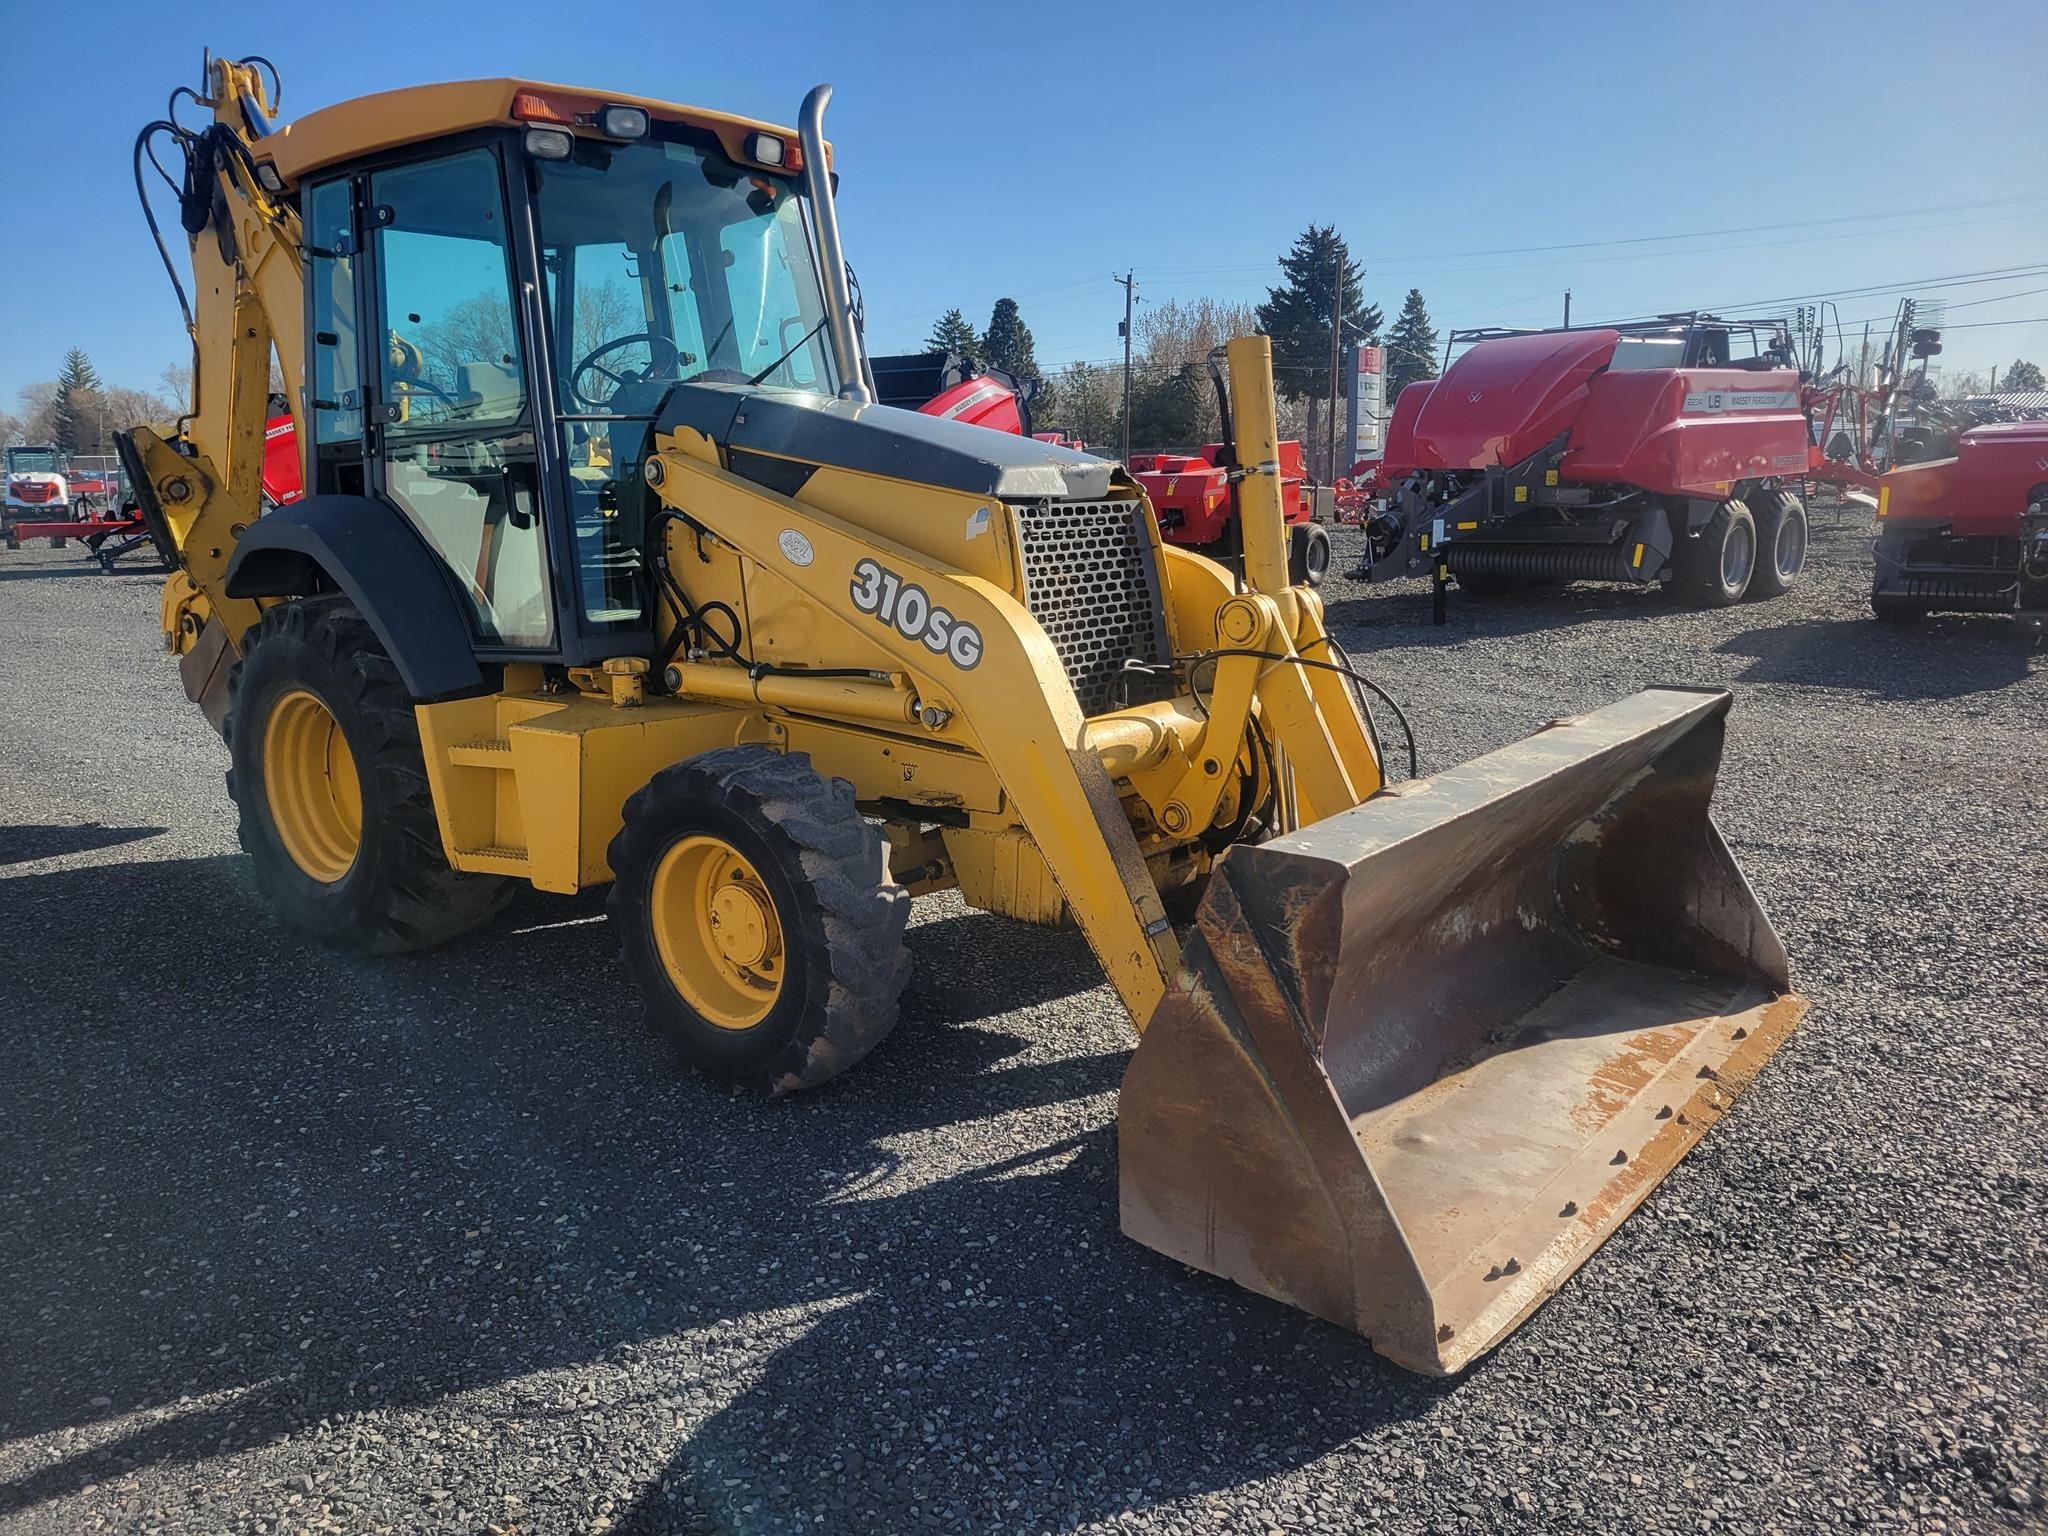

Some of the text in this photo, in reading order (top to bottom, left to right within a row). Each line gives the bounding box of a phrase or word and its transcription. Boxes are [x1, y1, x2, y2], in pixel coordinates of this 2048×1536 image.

[1708, 394, 1722, 409] LB
[1731, 396, 1751, 406] MASSEY
[1752, 395, 1777, 405] FERGUSON
[850, 558, 983, 671] 310SG
